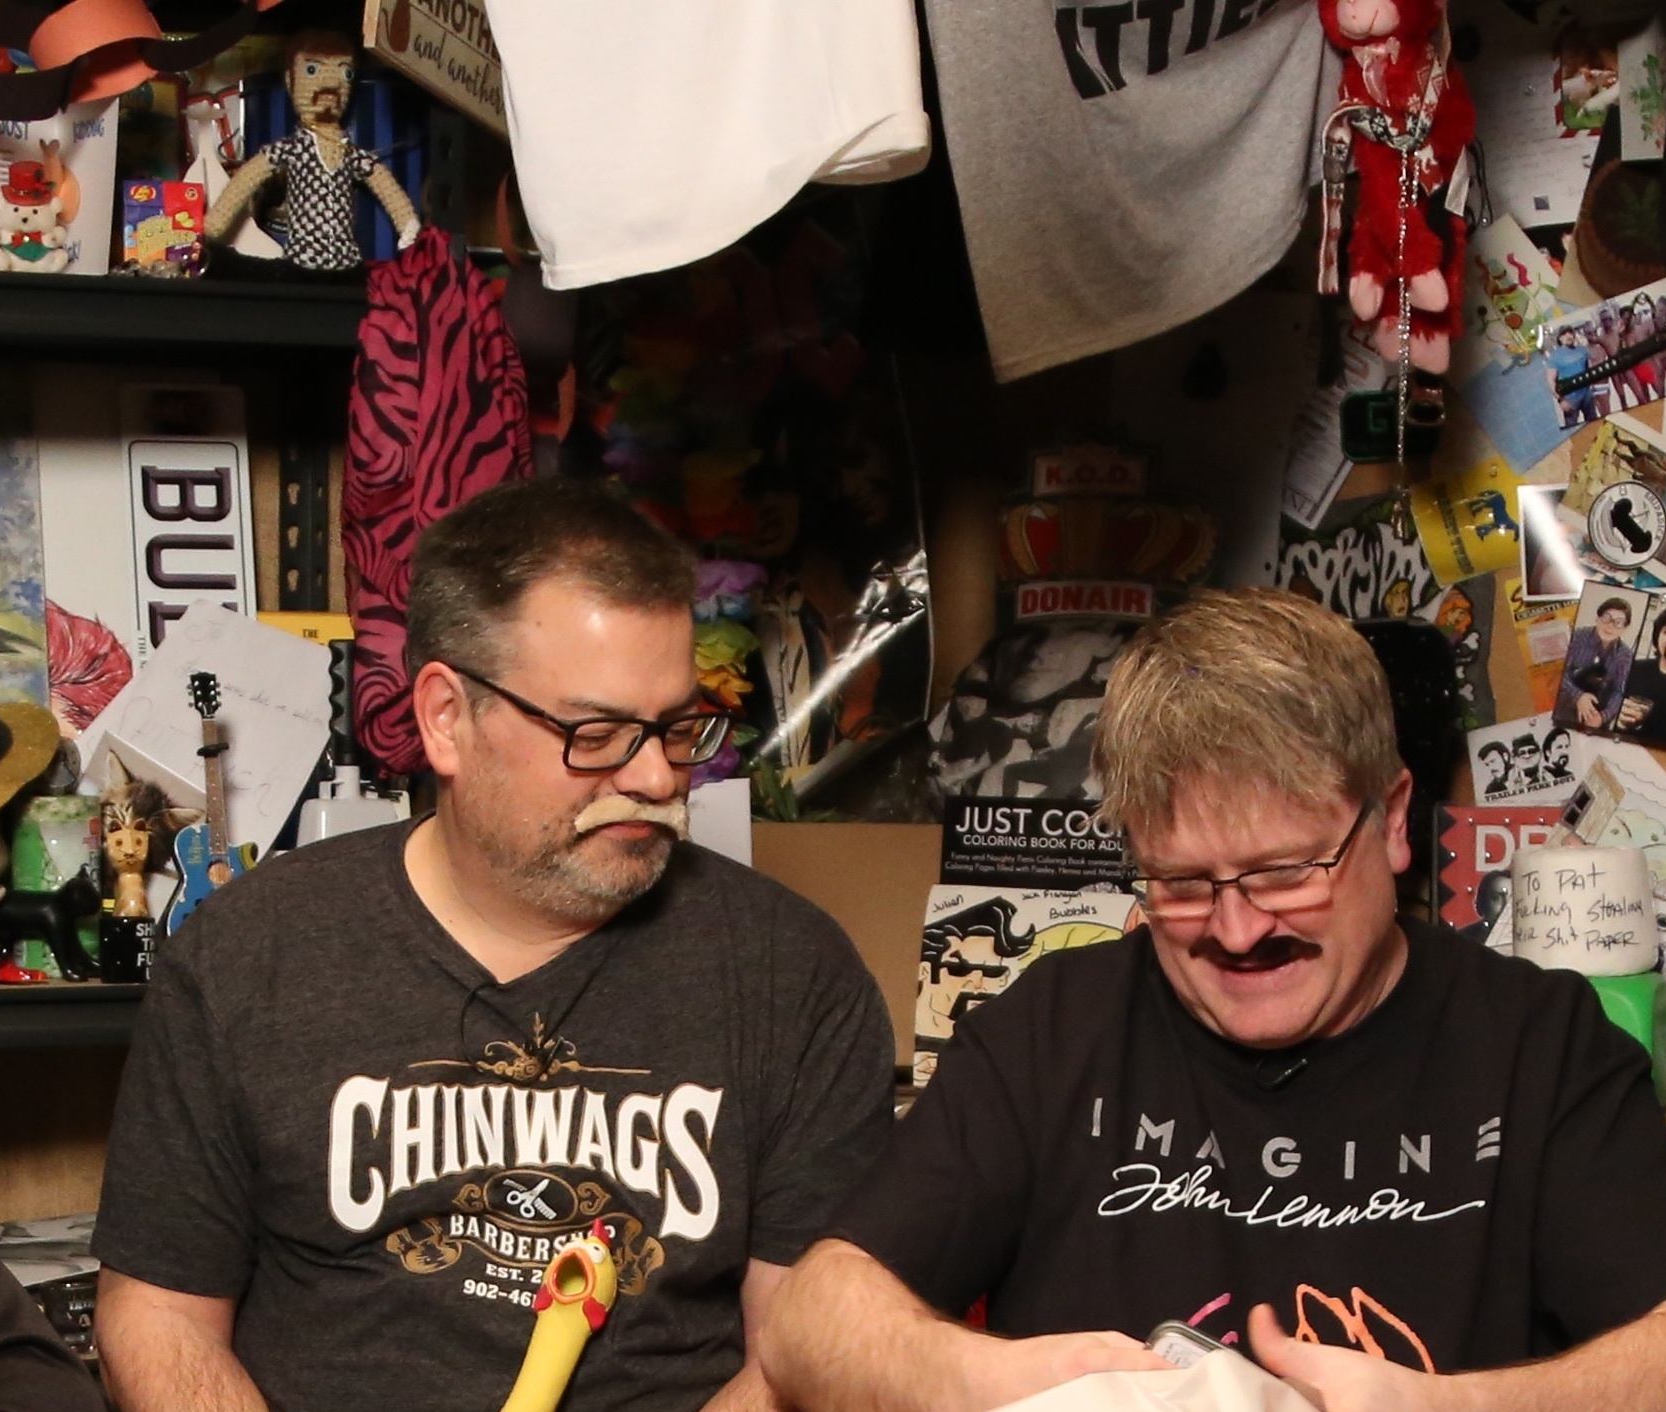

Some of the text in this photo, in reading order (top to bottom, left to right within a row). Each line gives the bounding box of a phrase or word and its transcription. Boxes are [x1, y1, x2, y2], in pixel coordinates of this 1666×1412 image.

[413, 32, 447, 70] and
[1020, 586, 1147, 617] DONAIR
[1484, 774, 1577, 803] TRAILER PARK BOYS
[955, 806, 1032, 834] JUST
[963, 833, 1027, 848] COLORING
[1030, 837, 1066, 850] BOOK
[1070, 837, 1095, 851] FOR
[1048, 903, 1099, 920] Bubbles
[1090, 1097, 1502, 1181] IMAGINE
[327, 1074, 724, 1242] CHINWAGS
[1097, 1163, 1487, 1229] John Lennon
[485, 1263, 525, 1283] EST.
